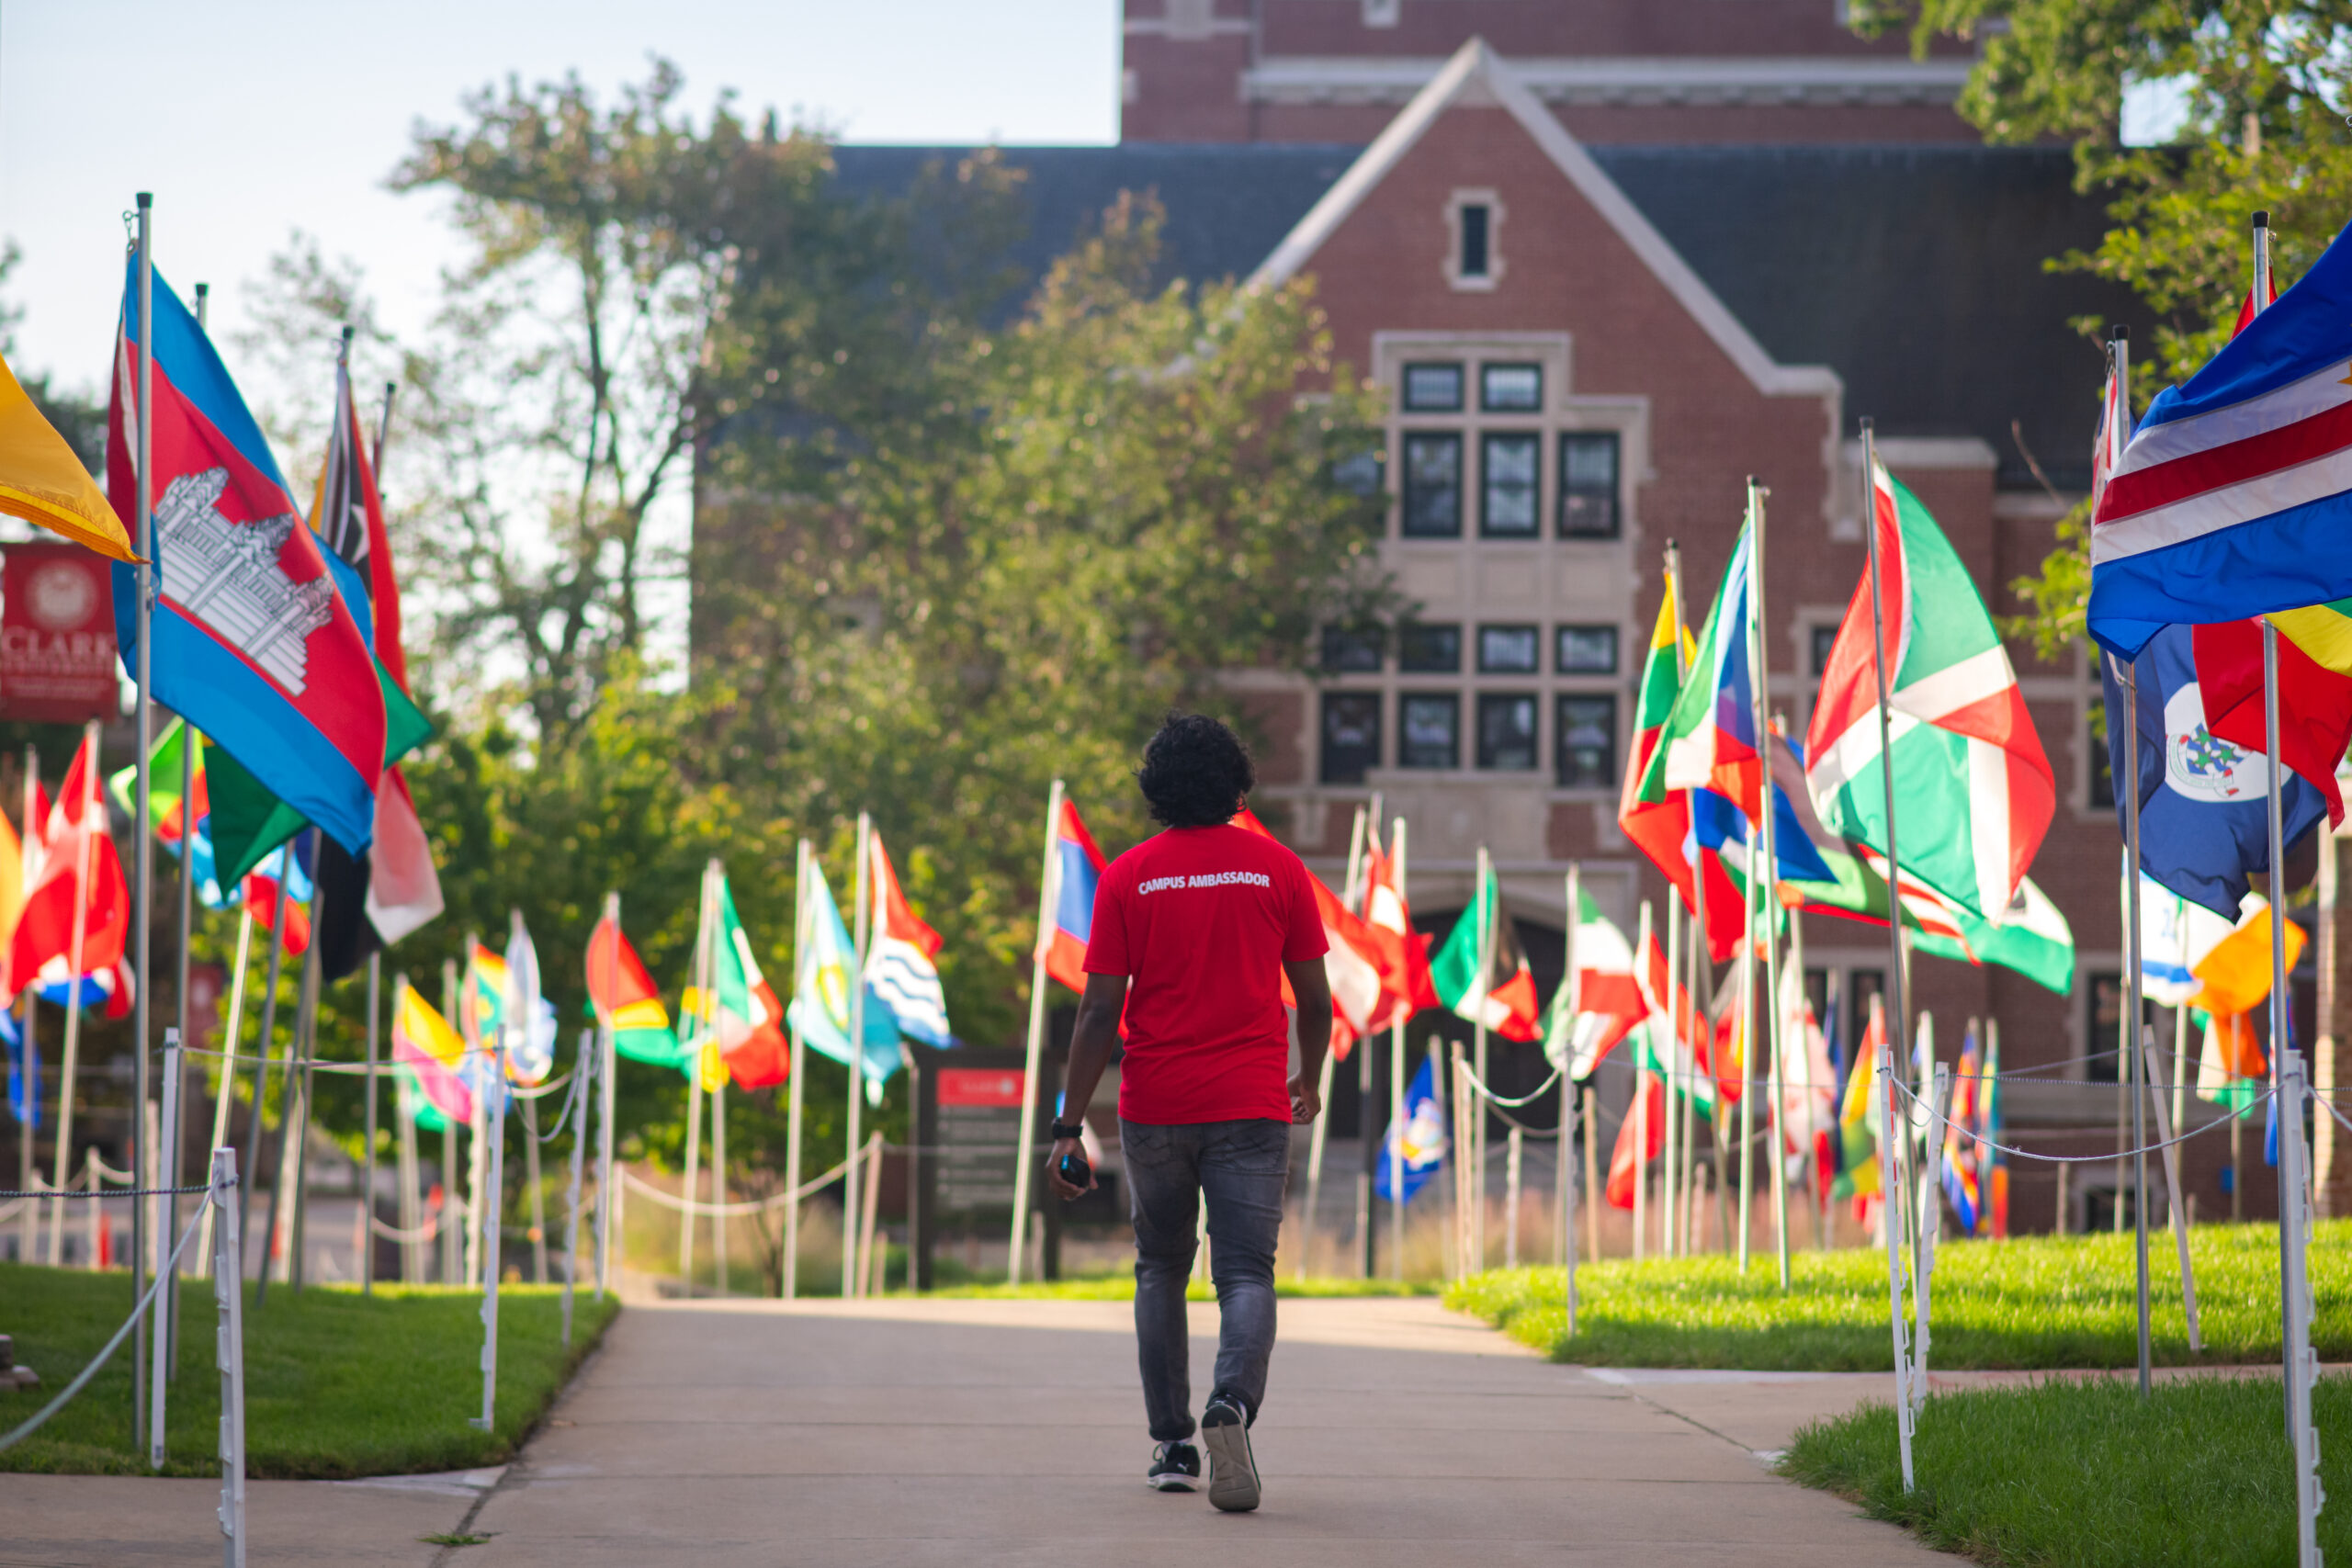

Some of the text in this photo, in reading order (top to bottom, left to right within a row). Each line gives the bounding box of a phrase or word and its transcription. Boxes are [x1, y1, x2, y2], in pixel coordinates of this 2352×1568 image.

[1, 626, 117, 658] CLARK
[1138, 872, 1269, 895] CAMPUS AMBASSADOR
